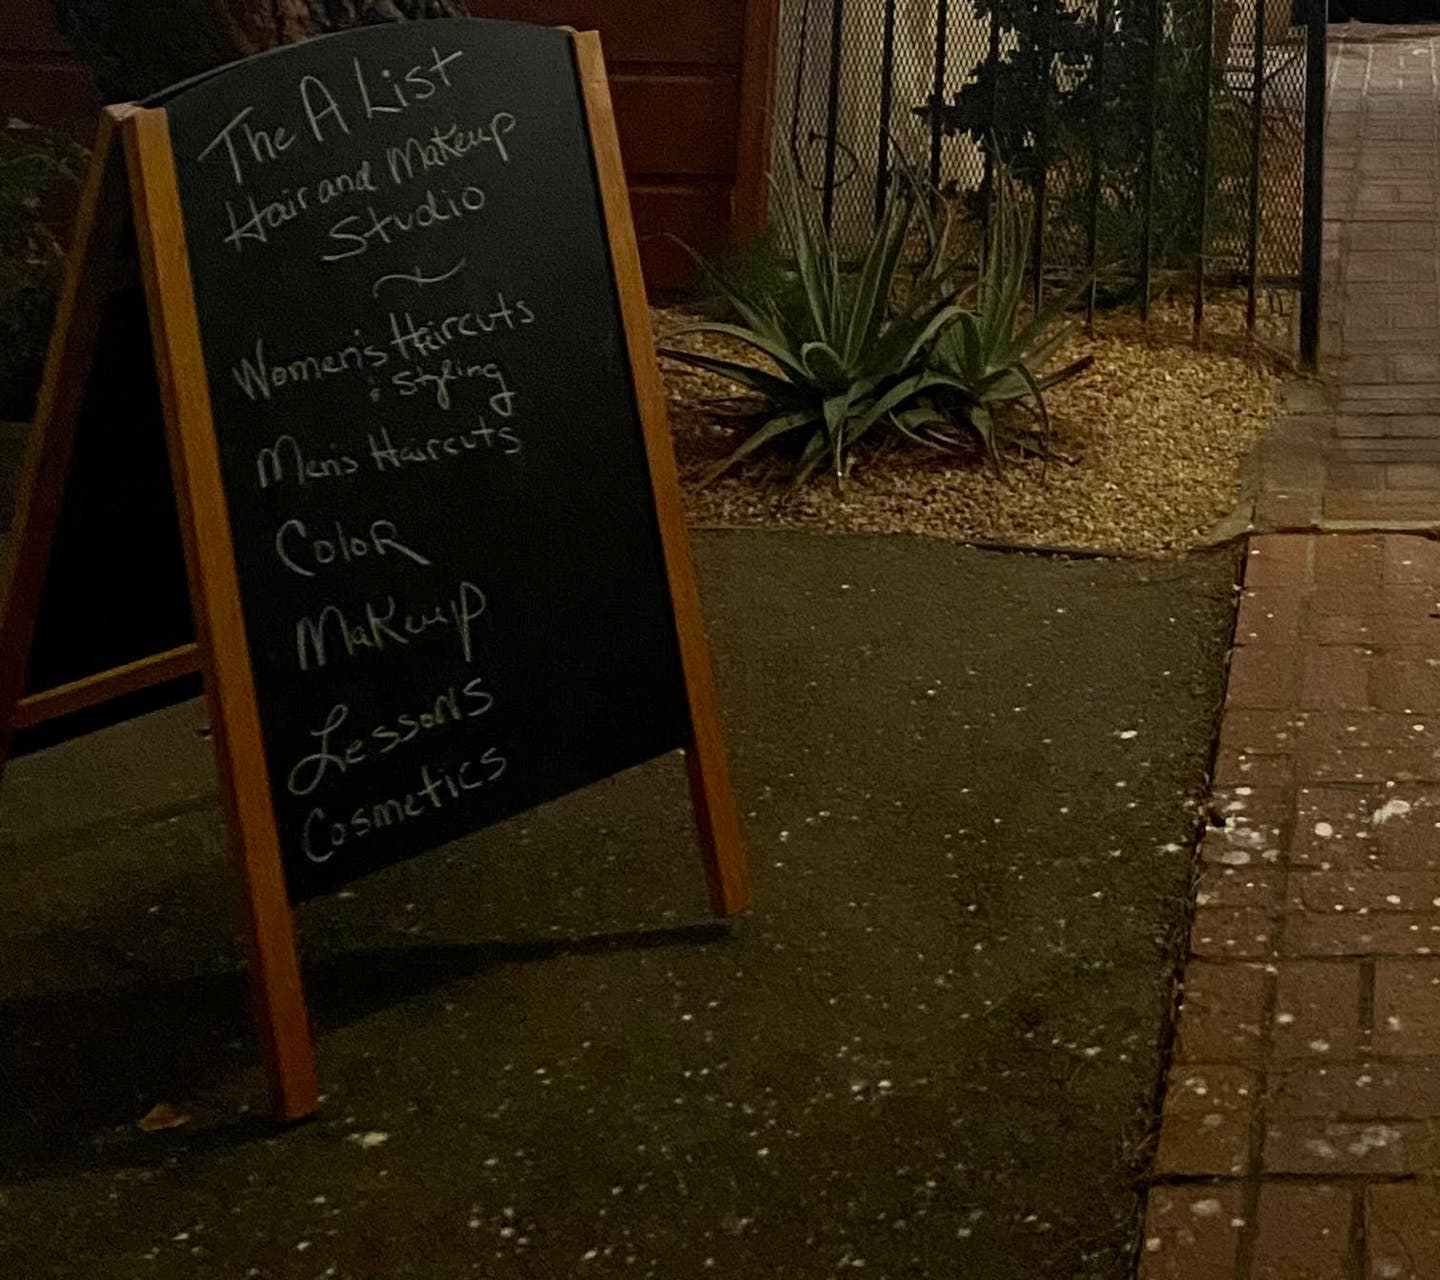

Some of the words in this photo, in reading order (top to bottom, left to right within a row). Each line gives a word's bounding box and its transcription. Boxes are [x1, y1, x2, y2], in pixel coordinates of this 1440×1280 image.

[199, 105, 298, 185] The
[300, 74, 351, 143] A
[352, 46, 464, 120] List
[224, 184, 309, 253] Hair
[317, 159, 379, 205] and
[320, 186, 486, 262] Studio
[390, 291, 535, 359] Haircuts
[391, 358, 518, 418] Styling
[367, 415, 522, 472] Haircuts
[303, 746, 508, 863] Cosmetics
